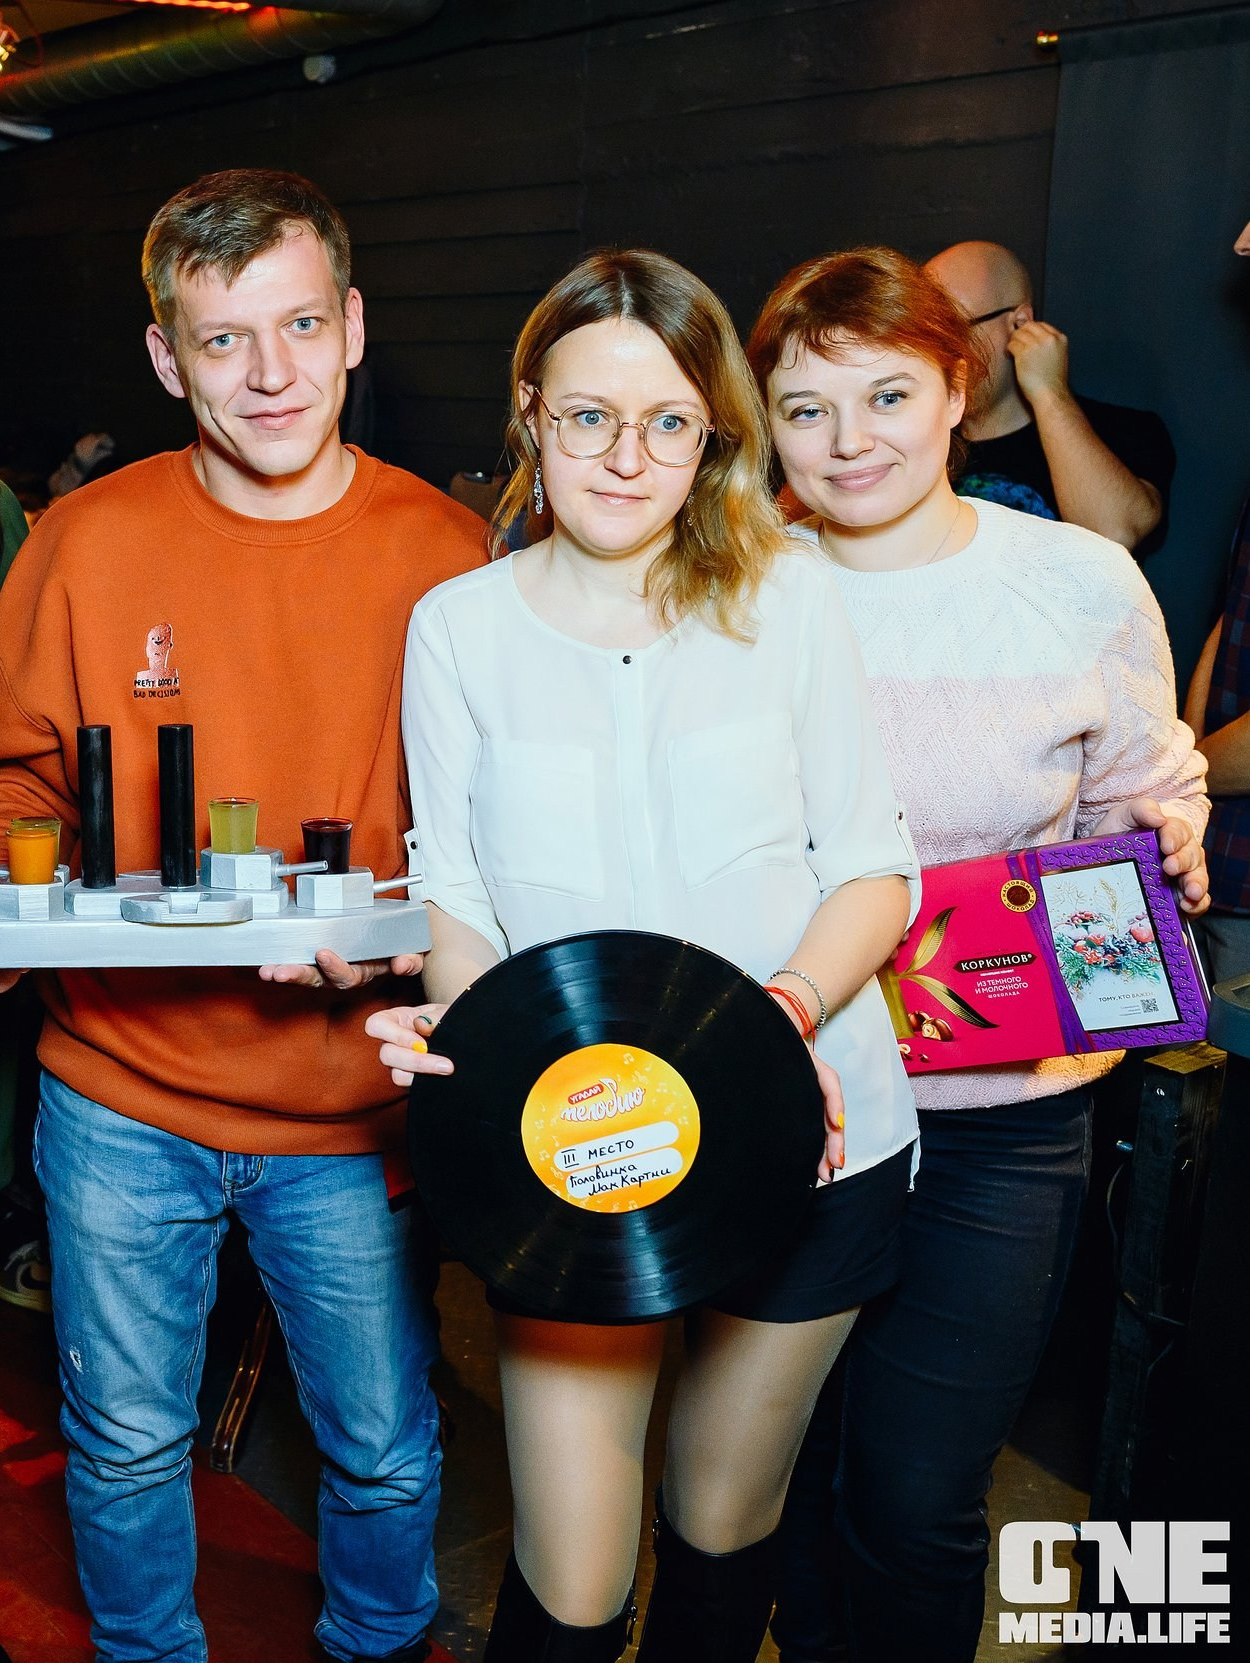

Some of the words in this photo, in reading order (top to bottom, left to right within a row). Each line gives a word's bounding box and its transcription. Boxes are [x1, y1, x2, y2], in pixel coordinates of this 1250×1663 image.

[133, 690, 146, 698] BAD
[148, 689, 181, 698] DECISIONS
[961, 954, 1028, 971] КОРКУНОВ
[981, 982, 1029, 993] МОЛОЧНОГО
[987, 976, 1022, 986] ТЕМНОГО
[561, 1149, 580, 1168] III
[588, 1140, 635, 1160] МЕСТО
[570, 1165, 637, 1188] Половинка
